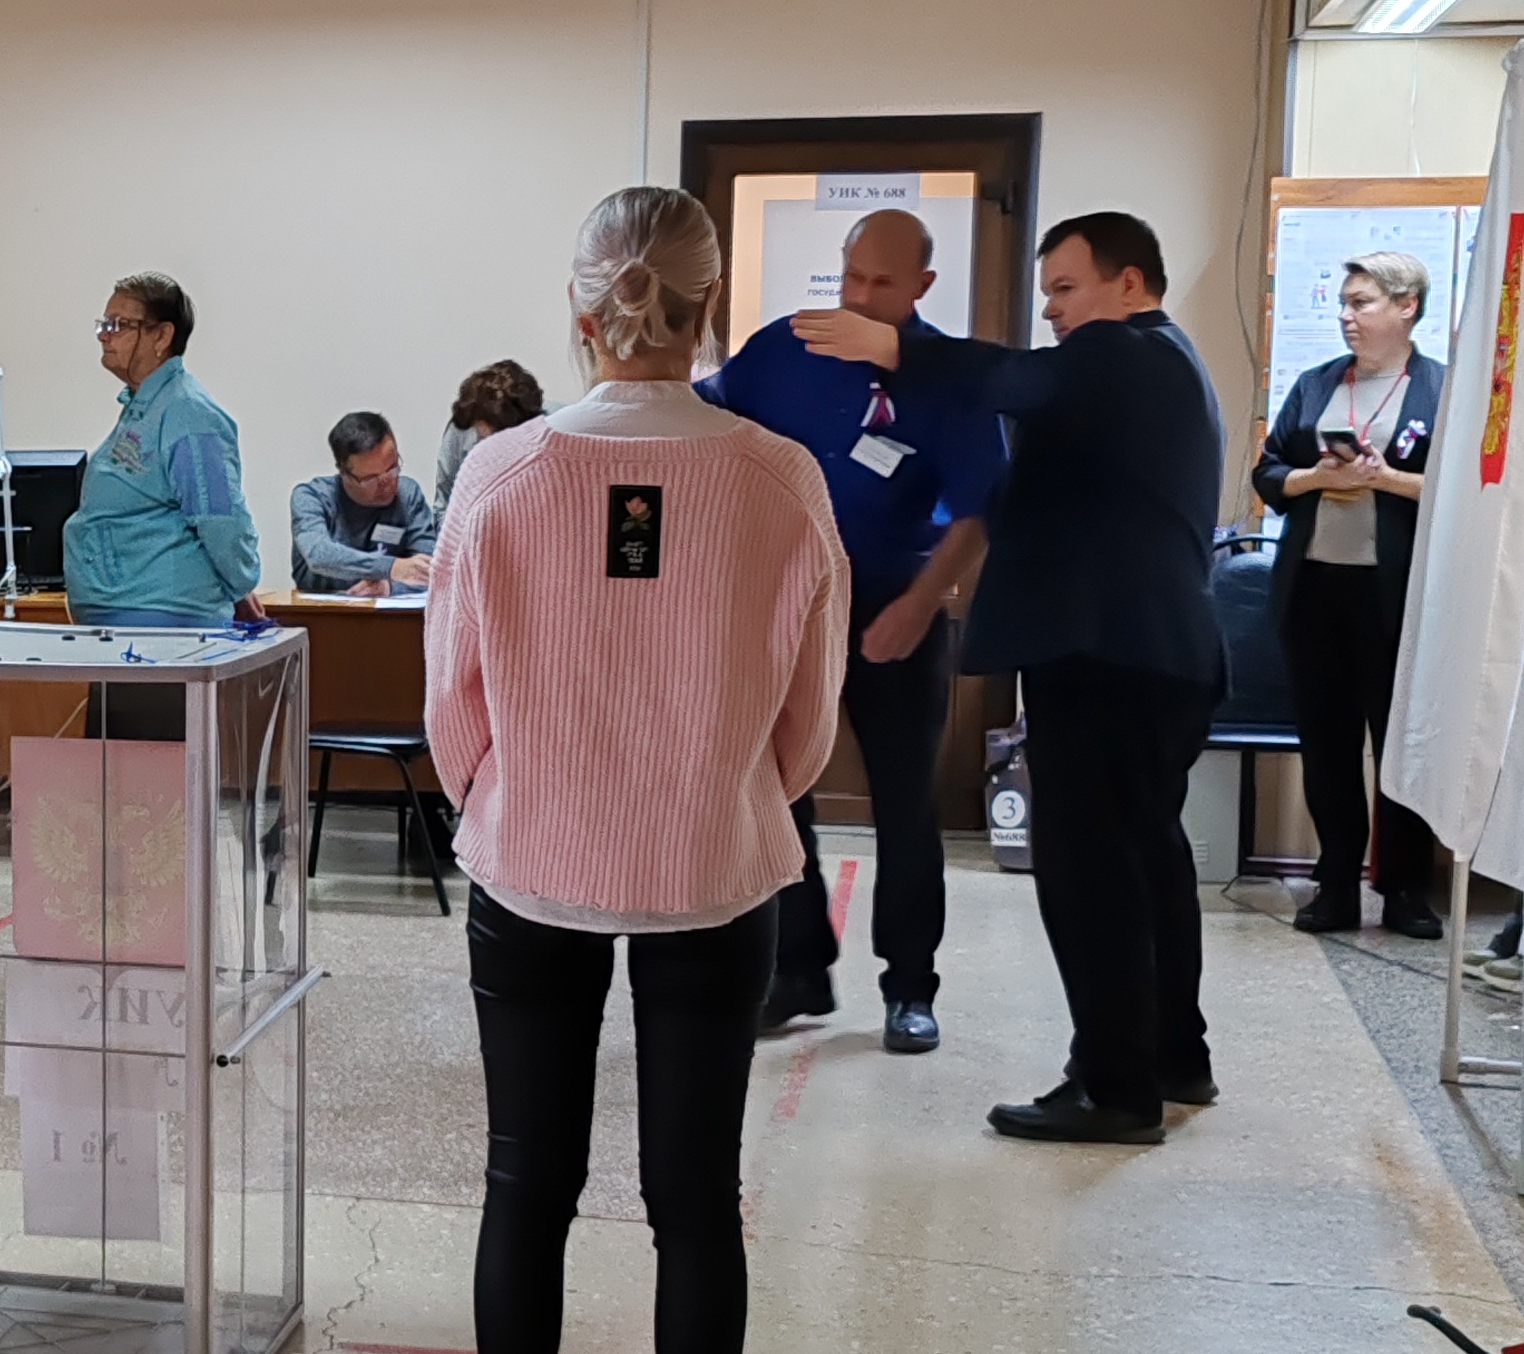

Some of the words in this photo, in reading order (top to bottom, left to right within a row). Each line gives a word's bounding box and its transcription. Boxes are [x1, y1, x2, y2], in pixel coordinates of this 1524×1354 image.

[827, 187, 862, 199] УИК
[864, 188, 880, 198] №
[883, 188, 907, 198] 688
[1001, 796, 1017, 820] 3
